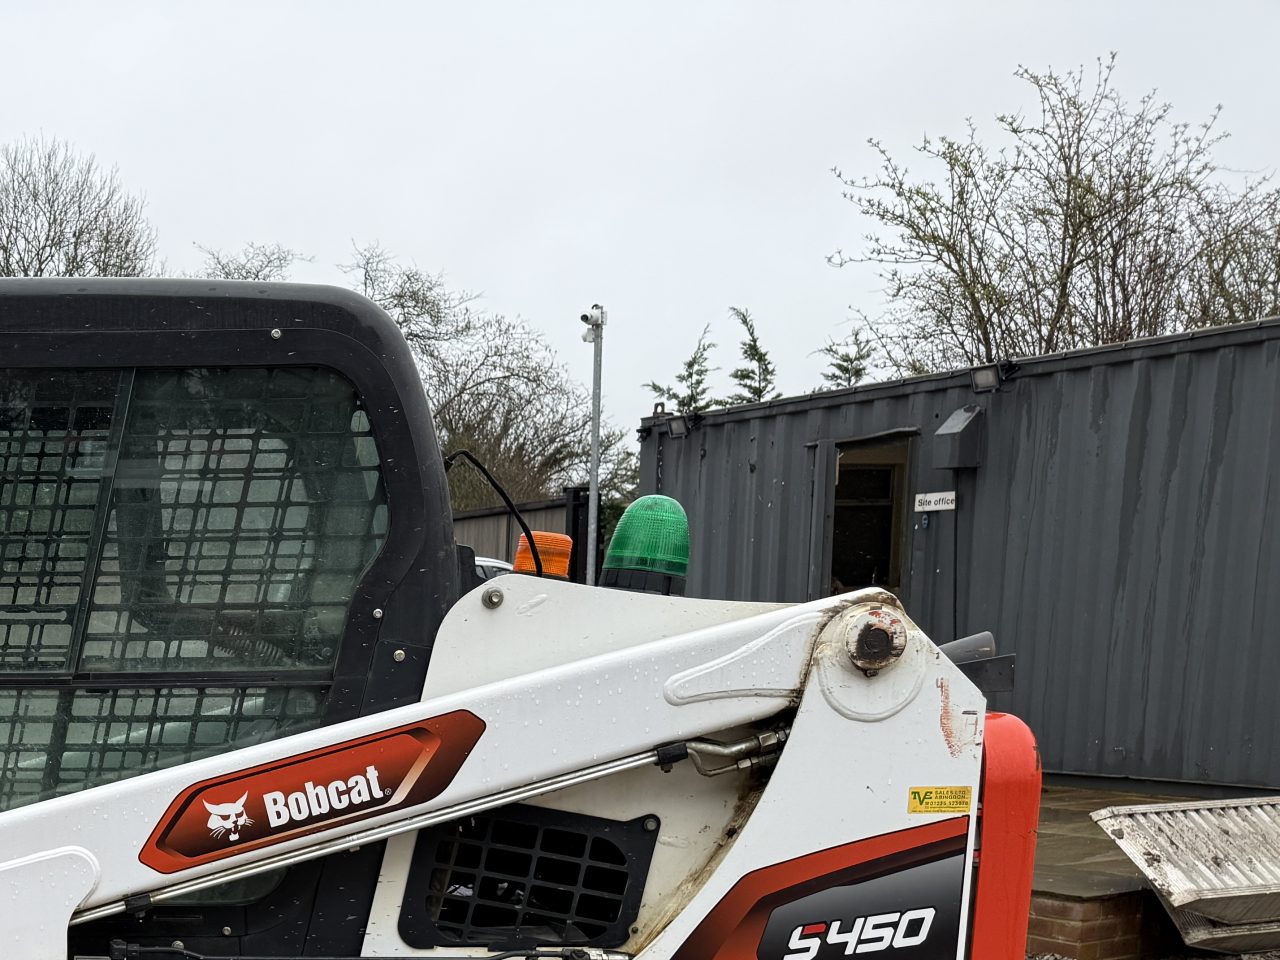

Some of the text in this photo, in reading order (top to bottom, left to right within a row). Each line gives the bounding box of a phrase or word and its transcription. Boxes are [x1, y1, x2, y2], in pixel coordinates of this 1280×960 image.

[918, 497, 955, 507] Site office
[262, 765, 383, 828] Bobcat
